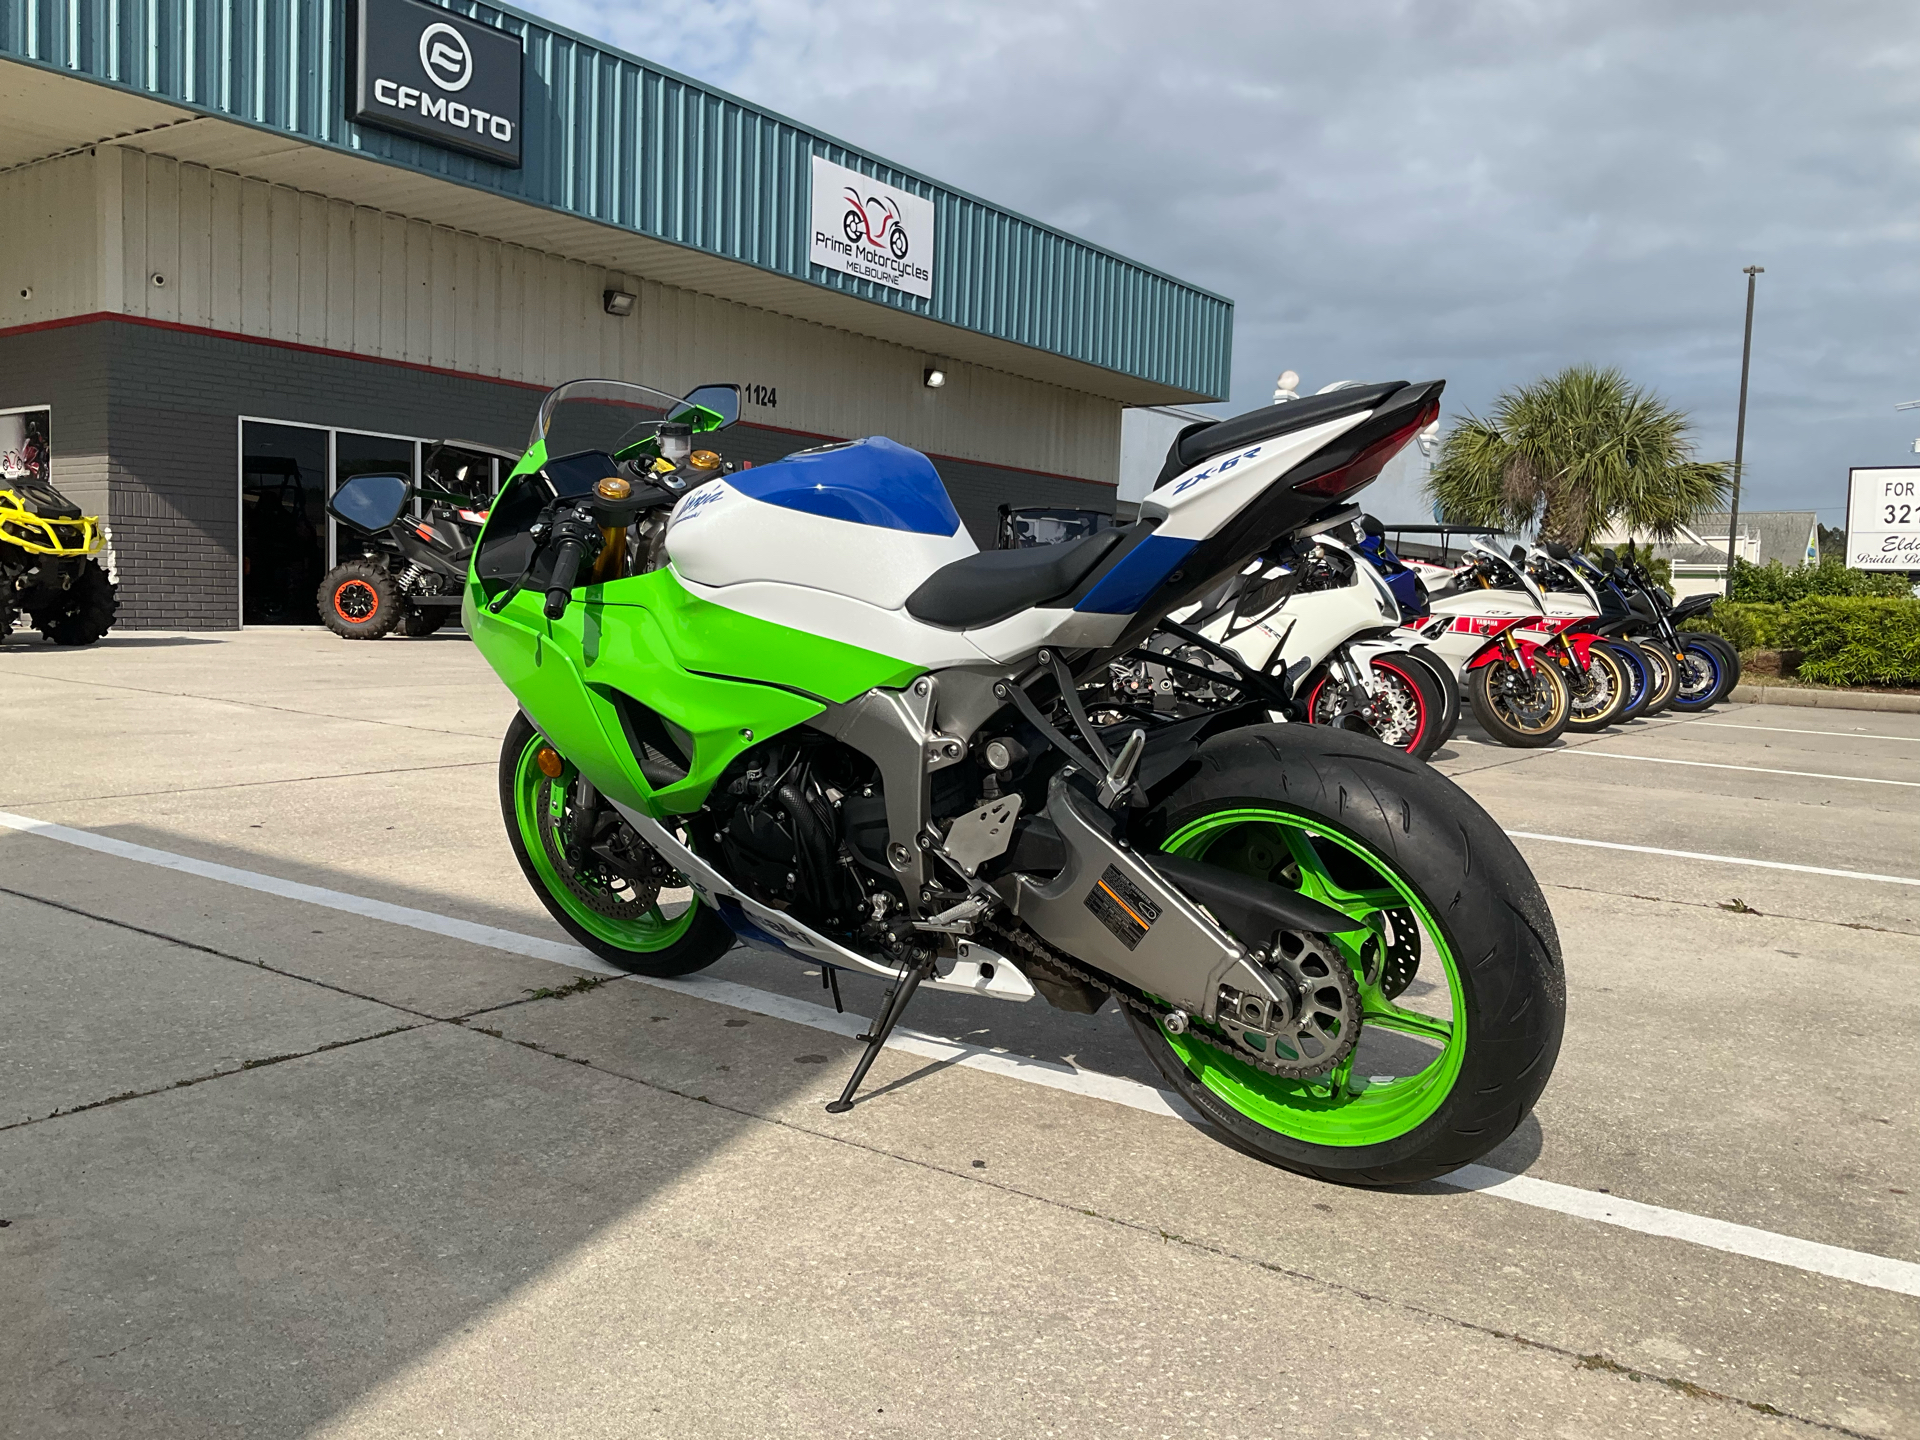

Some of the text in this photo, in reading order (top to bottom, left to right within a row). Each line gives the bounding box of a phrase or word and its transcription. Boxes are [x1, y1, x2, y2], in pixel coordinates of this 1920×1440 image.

[374, 78, 512, 143] CFMOTO
[815, 231, 929, 281] Prime Motorcycles
[846, 261, 900, 285] MELBOURNE
[745, 383, 777, 408] 1124
[1172, 446, 1262, 496] ZX-6R
[1884, 482, 1915, 497] FOR
[1855, 553, 1898, 564] Bridal
[1475, 618, 1498, 627] YAMAHA
